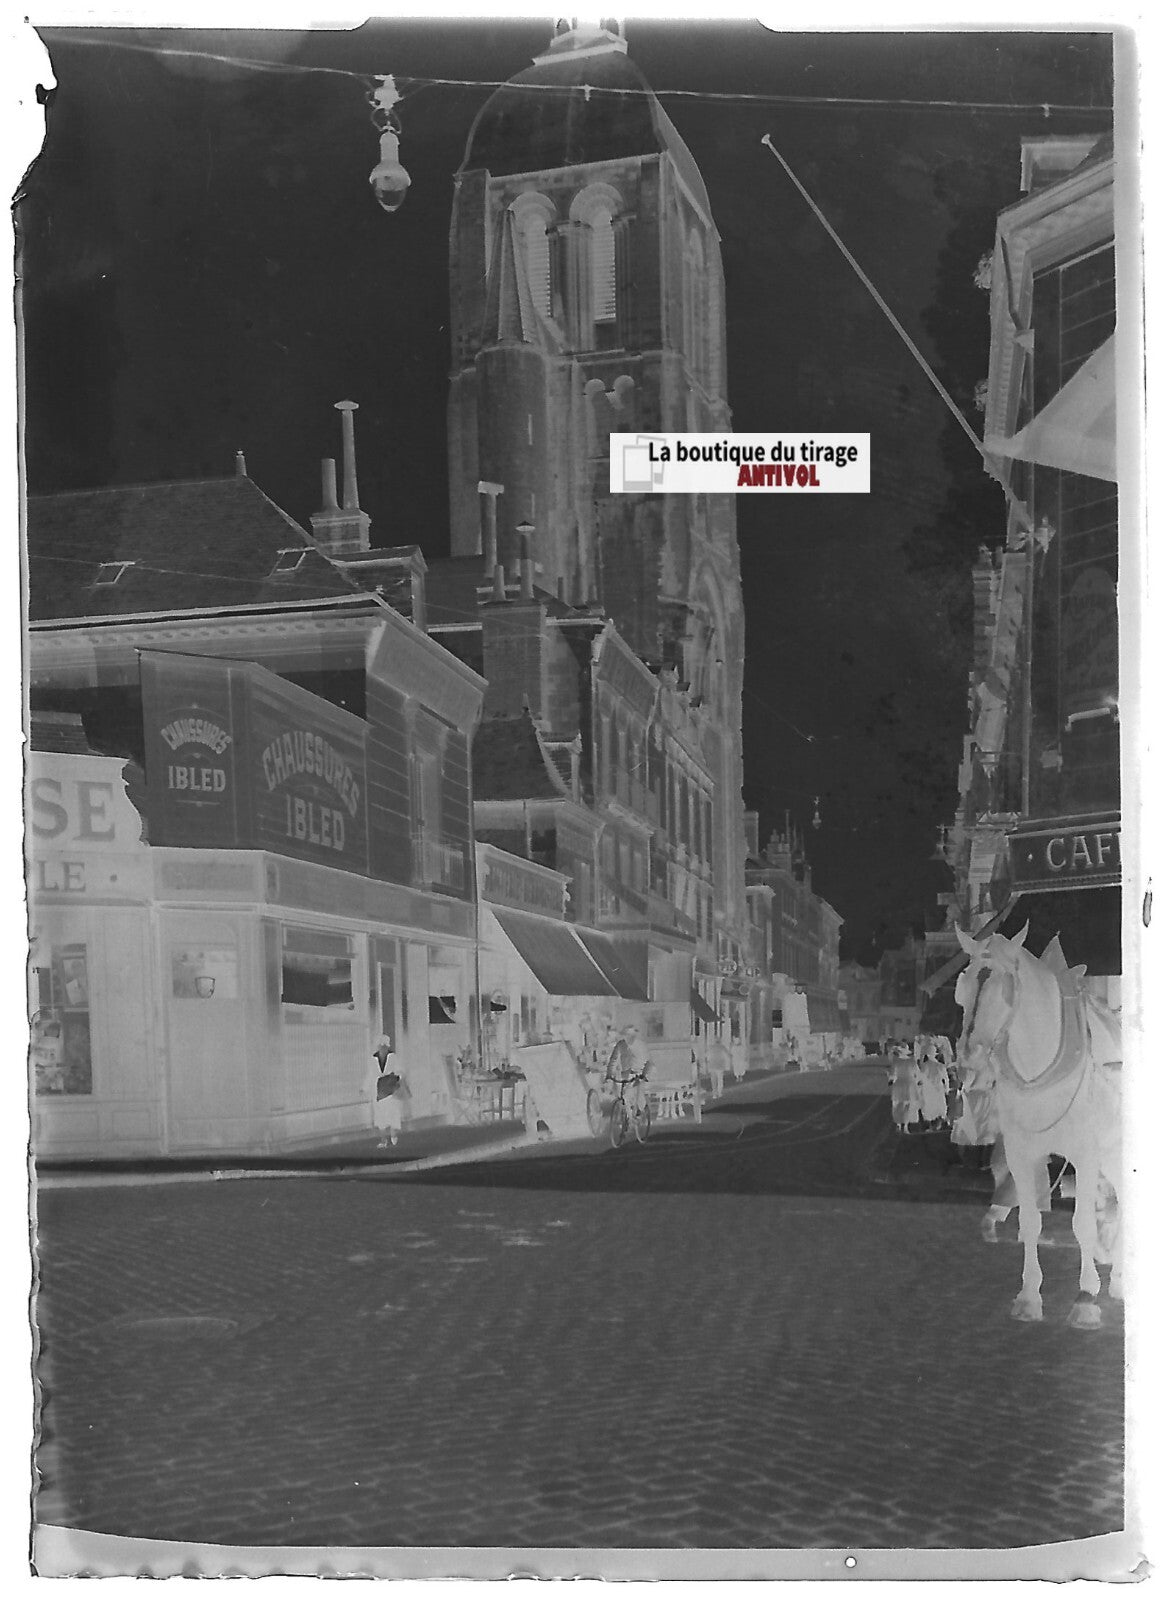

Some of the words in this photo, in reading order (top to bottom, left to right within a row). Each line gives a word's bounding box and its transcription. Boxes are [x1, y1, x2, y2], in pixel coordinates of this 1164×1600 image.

[161, 718, 233, 754] CHAUSSURES
[168, 765, 226, 792] IBLED
[262, 730, 360, 818] CHAUSSURES
[286, 793, 345, 851] IBLED
